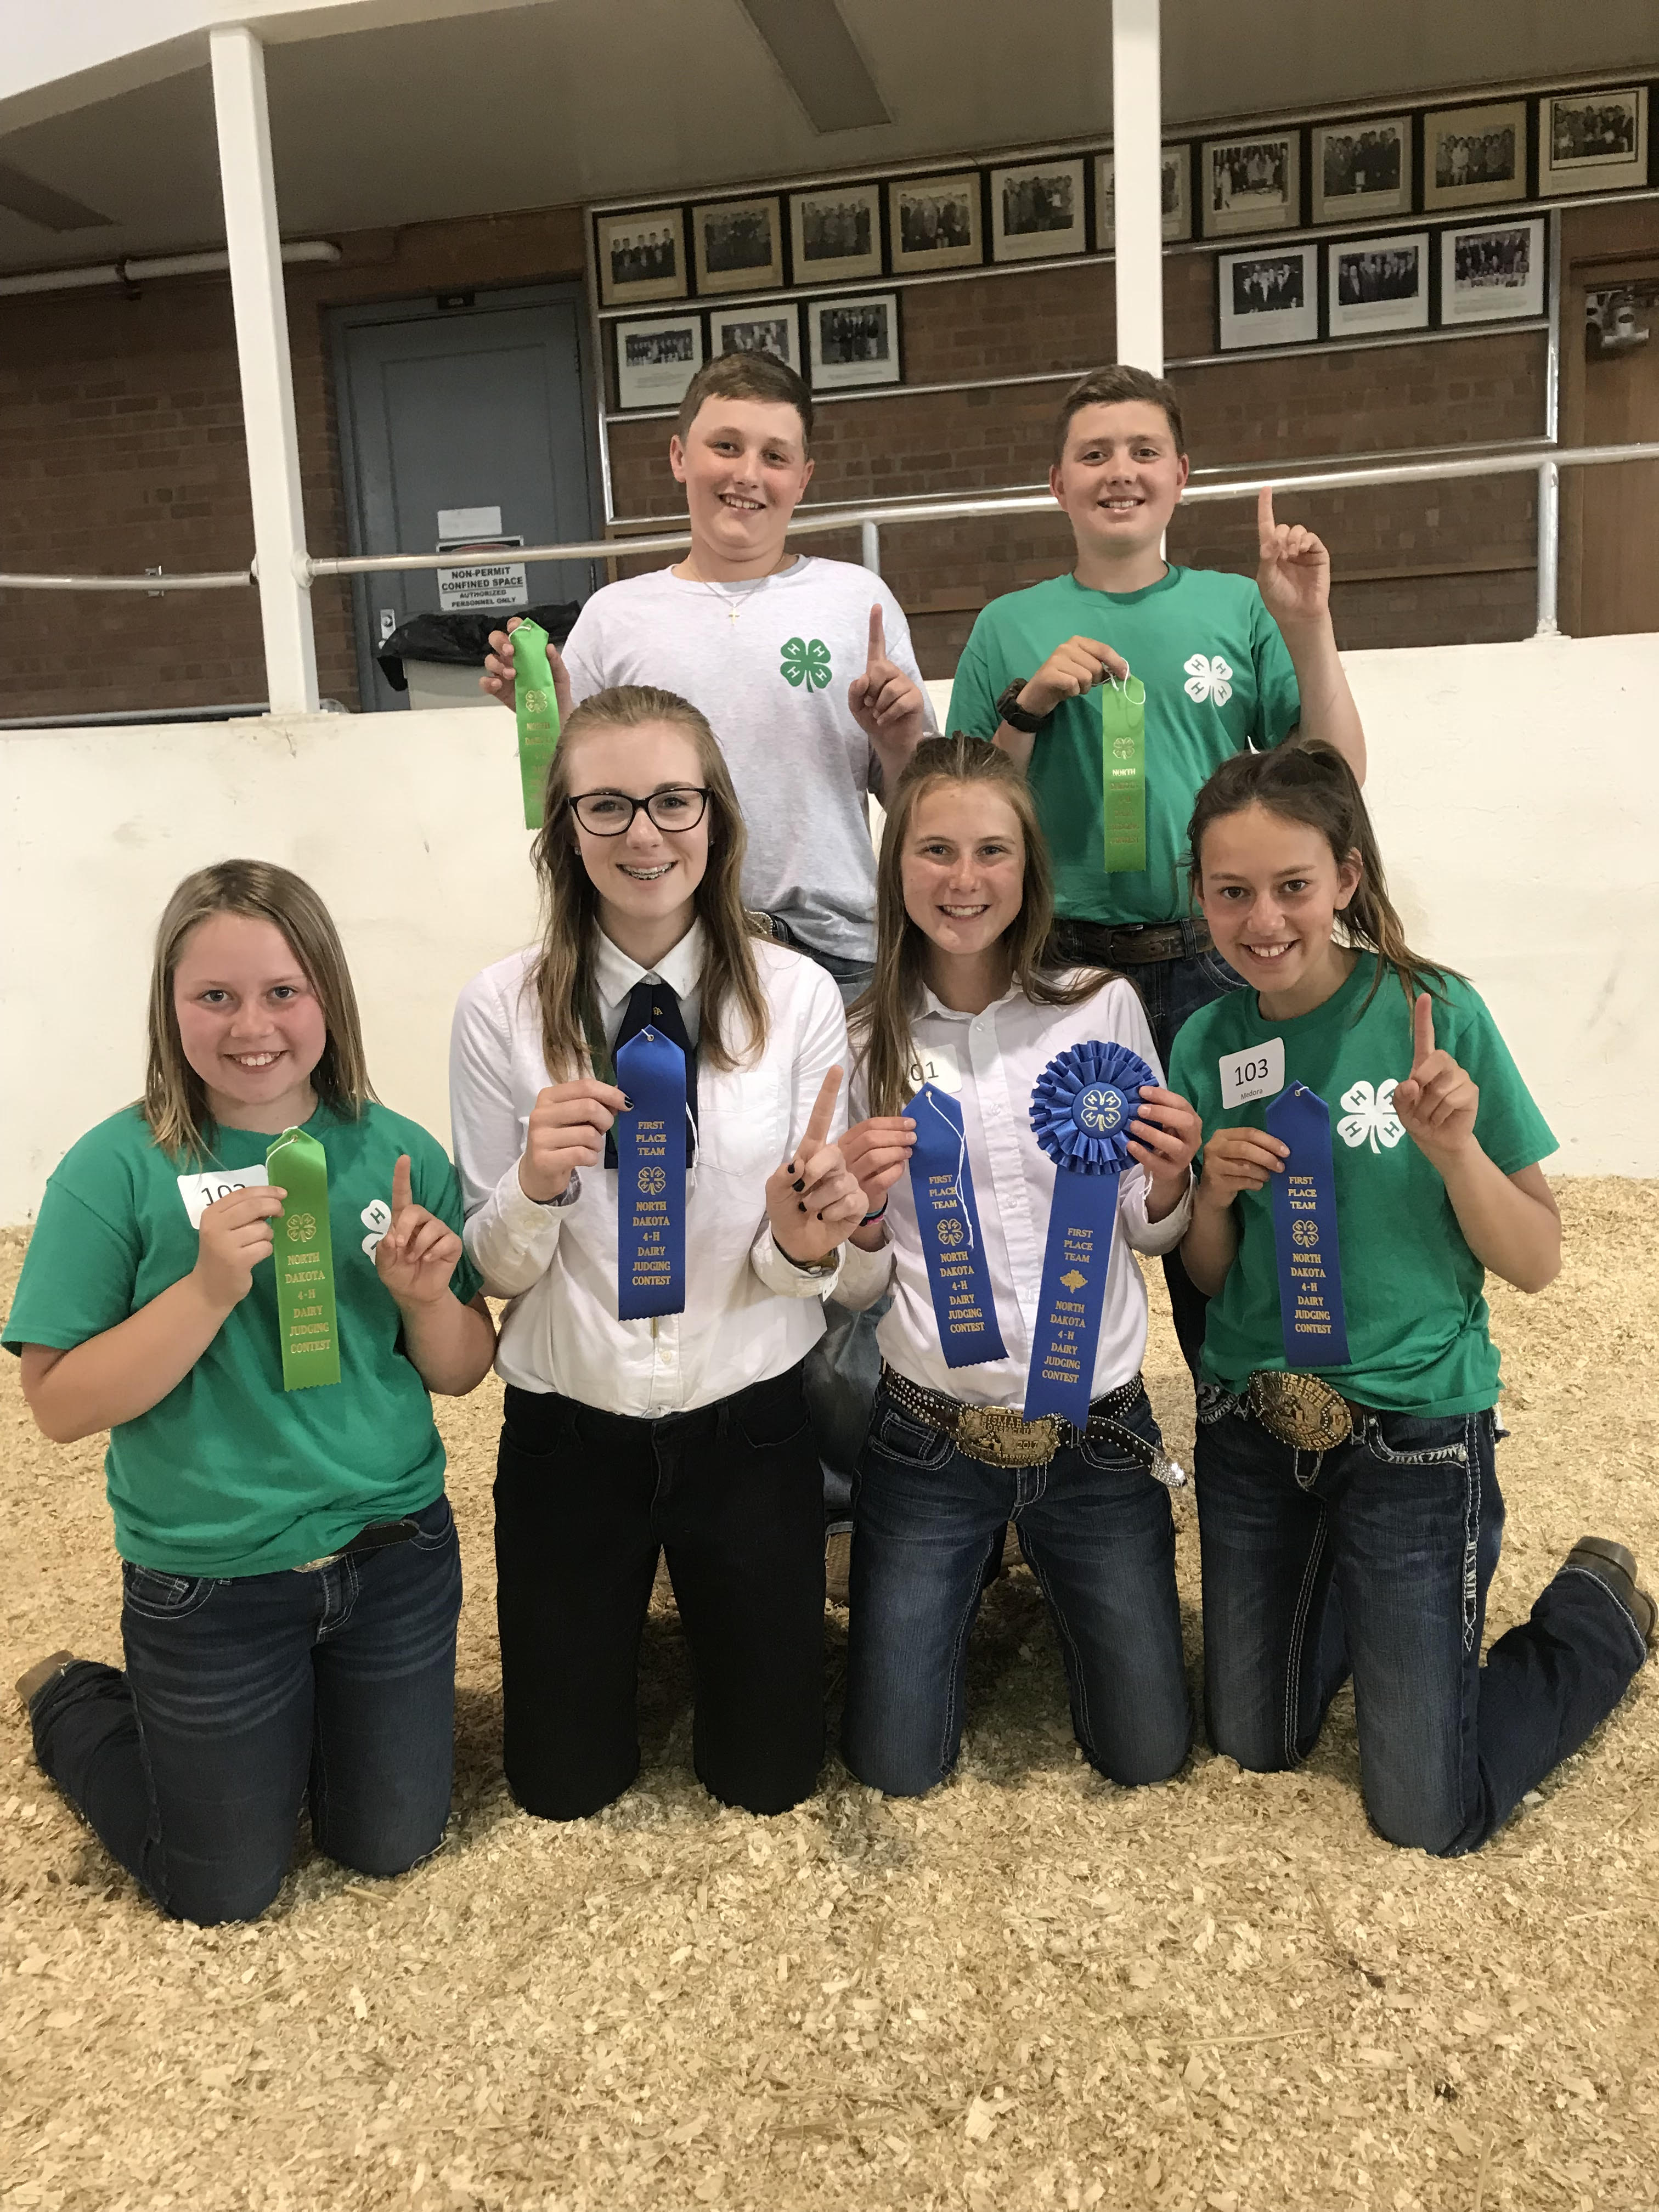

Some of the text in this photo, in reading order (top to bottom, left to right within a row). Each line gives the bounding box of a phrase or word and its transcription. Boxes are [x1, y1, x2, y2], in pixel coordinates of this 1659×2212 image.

[452, 567, 511, 579] NON-PERMIT
[442, 577, 523, 590] CONFINED SPACE
[460, 590, 506, 599] AUTHORIZED
[452, 599, 495, 607] PERSONNEL
[787, 643, 800, 655] H
[813, 646, 825, 657] H
[1192, 659, 1204, 671] H
[1216, 663, 1226, 674] H
[787, 666, 800, 678] H
[815, 668, 827, 681] H
[1191, 681, 1204, 695] H
[1218, 686, 1227, 699] H
[1112, 768, 1136, 776] NORTH
[910, 1061, 939, 1081] 01
[1235, 1058, 1268, 1086] 103
[1087, 1094, 1097, 1105] H
[1240, 1088, 1263, 1100] Medora
[1350, 1090, 1367, 1106] H
[1106, 1096, 1116, 1105] H
[1086, 1111, 1096, 1121] H
[1106, 1113, 1116, 1124] H
[638, 1121, 664, 1130] FIRST
[1345, 1121, 1362, 1138] H
[1384, 1121, 1400, 1138] H
[636, 1135, 667, 1143] PLACE
[637, 1147, 665, 1156] TEAM
[929, 1175, 953, 1184] FIRST
[1289, 1176, 1314, 1185] FIRST
[929, 1187, 957, 1197] PLACE
[1288, 1189, 1317, 1198] PLACE
[636, 1201, 667, 1211] NORTH
[932, 1200, 957, 1210] TEAM
[1290, 1201, 1316, 1210] TEAM
[370, 1207, 386, 1224] H
[633, 1216, 670, 1226] DAKOTA
[643, 1232, 660, 1241] 4-H
[1068, 1227, 1093, 1238] FIRST
[1064, 1239, 1093, 1251] PLACE
[637, 1246, 665, 1256] DAIRY
[287, 1252, 320, 1266] NORTH
[940, 1251, 968, 1263] NORTH
[1064, 1251, 1091, 1263] TEAM
[1293, 1253, 1322, 1263] NORTH
[633, 1261, 670, 1271] JUDGING
[940, 1266, 974, 1277] DAKOTA
[285, 1271, 325, 1284] DAKOTA
[1290, 1267, 1327, 1278] DAKOTA
[632, 1276, 671, 1285] CONTEST
[952, 1280, 968, 1291] 4-H
[1301, 1283, 1318, 1292] 4-H
[298, 1289, 316, 1300] 4-H
[949, 1294, 975, 1305] DAIRY
[1297, 1295, 1324, 1307] DAIRY
[294, 1305, 323, 1318] DAIRY
[1055, 1300, 1085, 1314] NORTH
[948, 1308, 983, 1320] JUDGING
[1295, 1309, 1330, 1321] JUDGING
[1049, 1314, 1086, 1328] DAKOTA
[290, 1323, 329, 1336] JUDGING
[950, 1322, 985, 1333] CONTEST
[1295, 1323, 1331, 1334] CONTEST
[1058, 1330, 1074, 1340] 4-H
[291, 1340, 331, 1354] CONTEST
[1051, 1342, 1079, 1356] DAIRY
[1044, 1356, 1081, 1370] JUDGING
[1042, 1369, 1080, 1384] CONTEST
[981, 1423, 1008, 1433] HORSE
[1017, 1441, 1039, 1449] 2017
